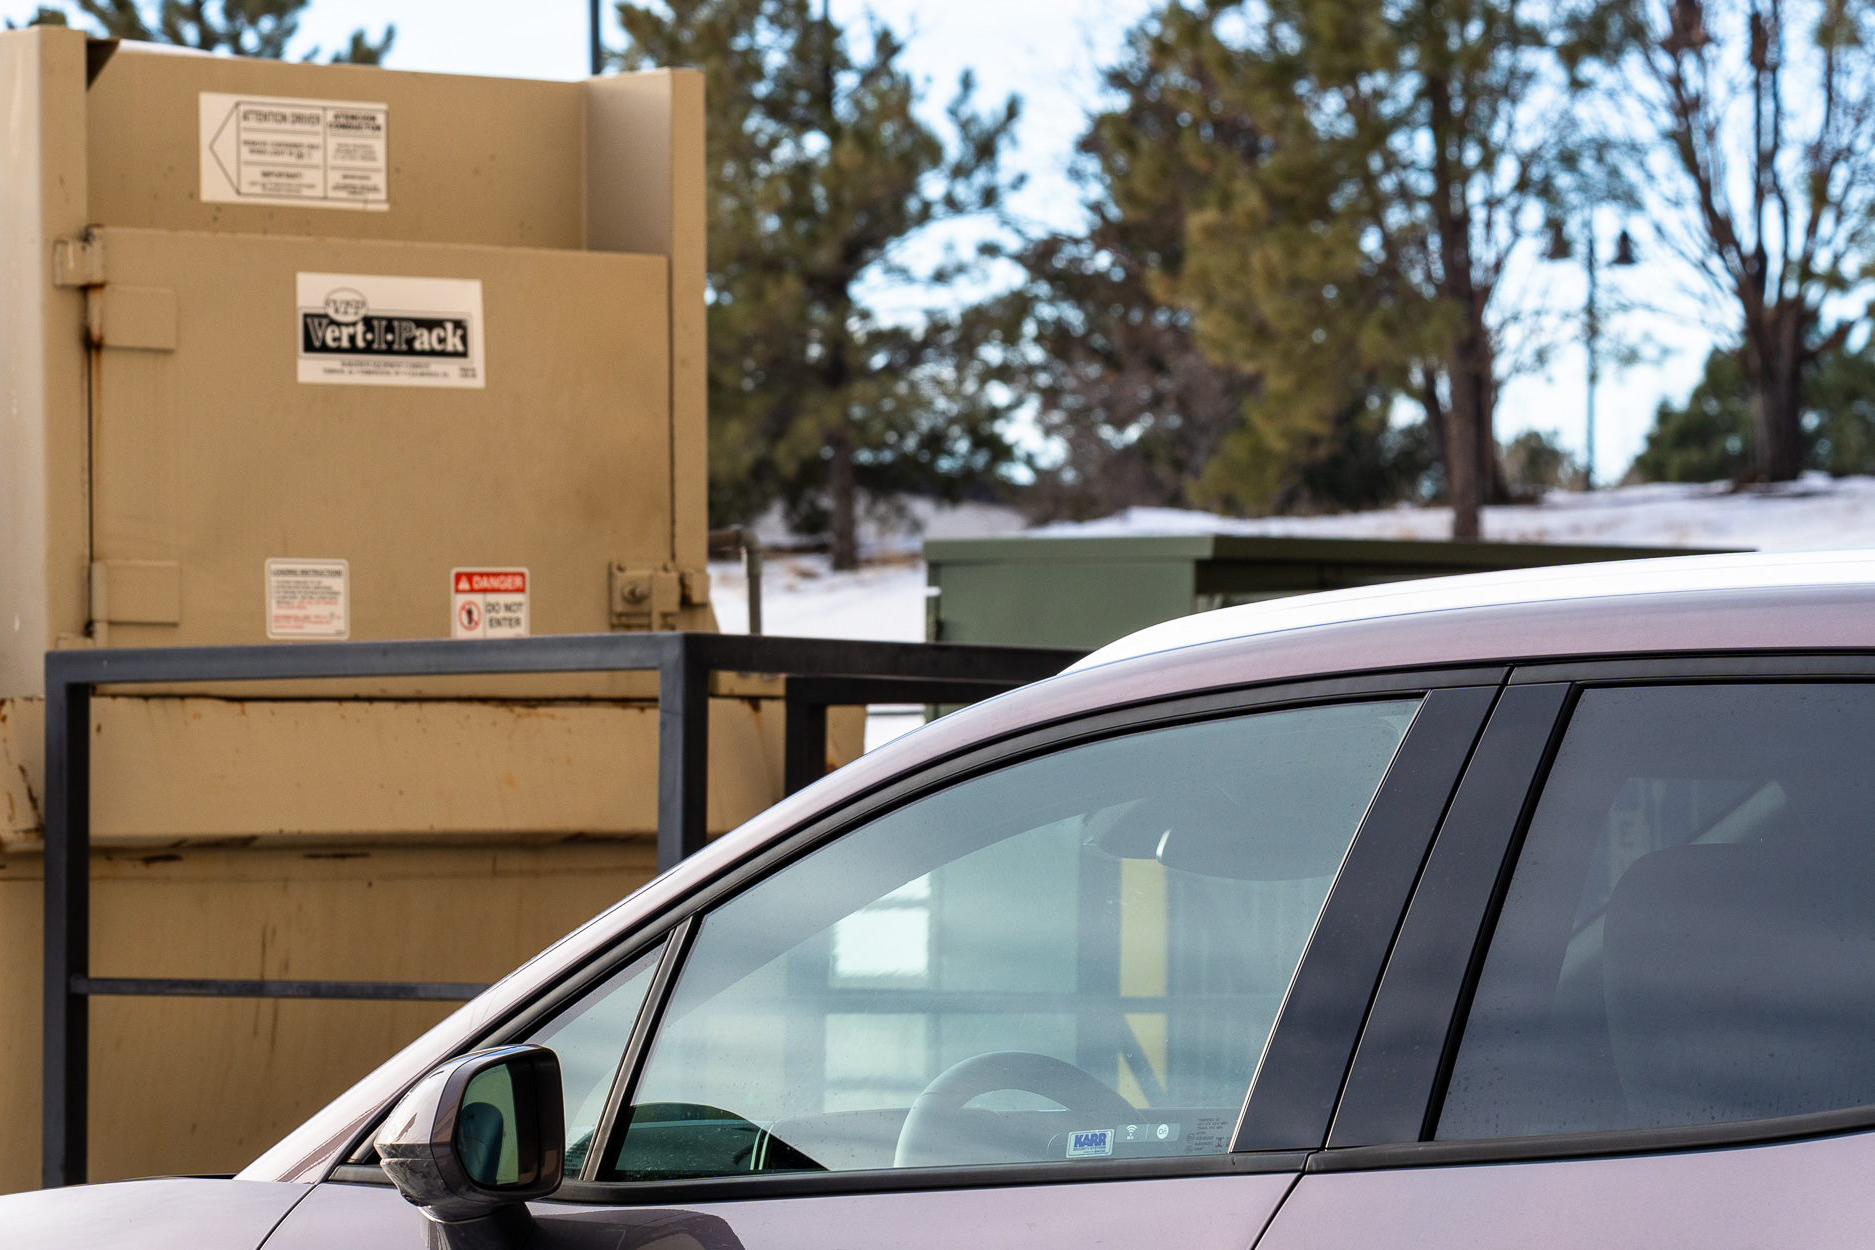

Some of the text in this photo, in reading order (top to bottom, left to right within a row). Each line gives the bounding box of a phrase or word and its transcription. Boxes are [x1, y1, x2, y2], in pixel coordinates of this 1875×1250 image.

[471, 574, 524, 591] DANGER
[486, 602, 523, 614] DO NOT
[489, 616, 522, 629] ENTER
[1074, 1132, 1107, 1147] KARR
